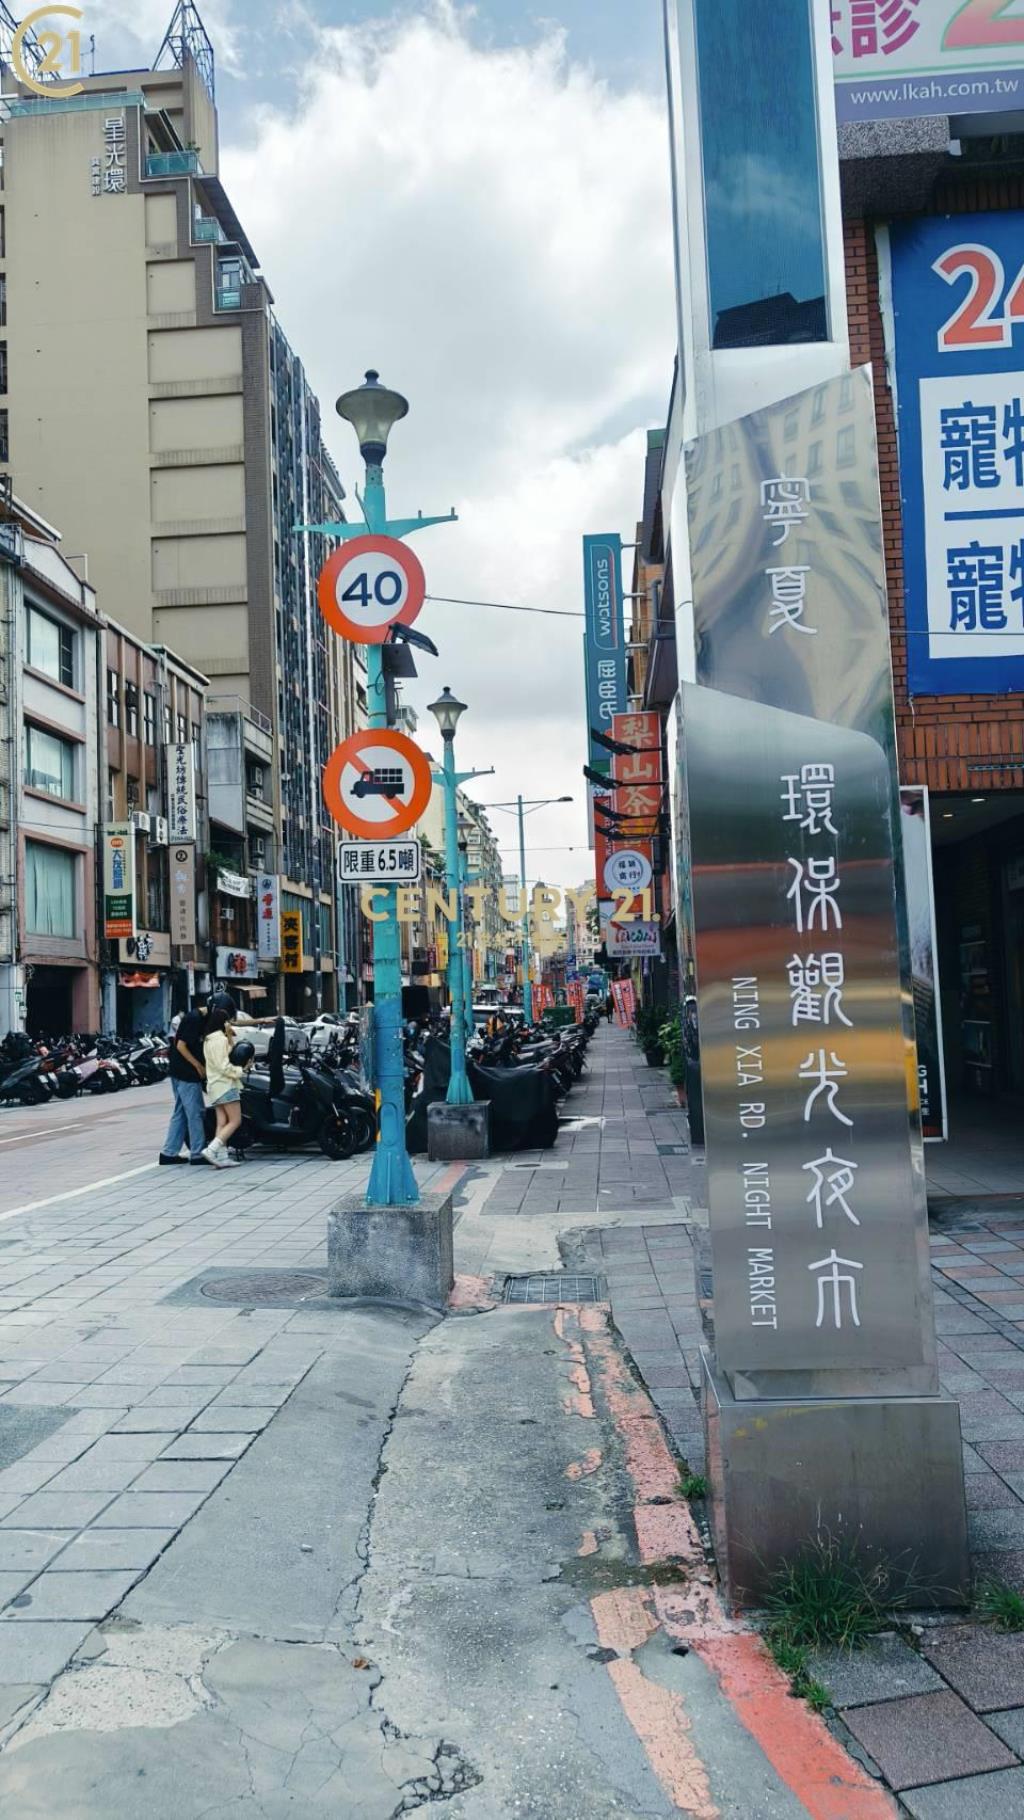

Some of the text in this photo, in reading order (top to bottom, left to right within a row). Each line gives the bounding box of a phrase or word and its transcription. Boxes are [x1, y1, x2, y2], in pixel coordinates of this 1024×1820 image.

[851, 78, 1019, 104] www.lkah.com.tw
[341, 571, 403, 607] 40
[597, 558, 610, 637] watsons
[780, 763, 864, 1330] 環保觀光夜市
[731, 976, 778, 1330] NING XIA RD. NIGHT MARKET
